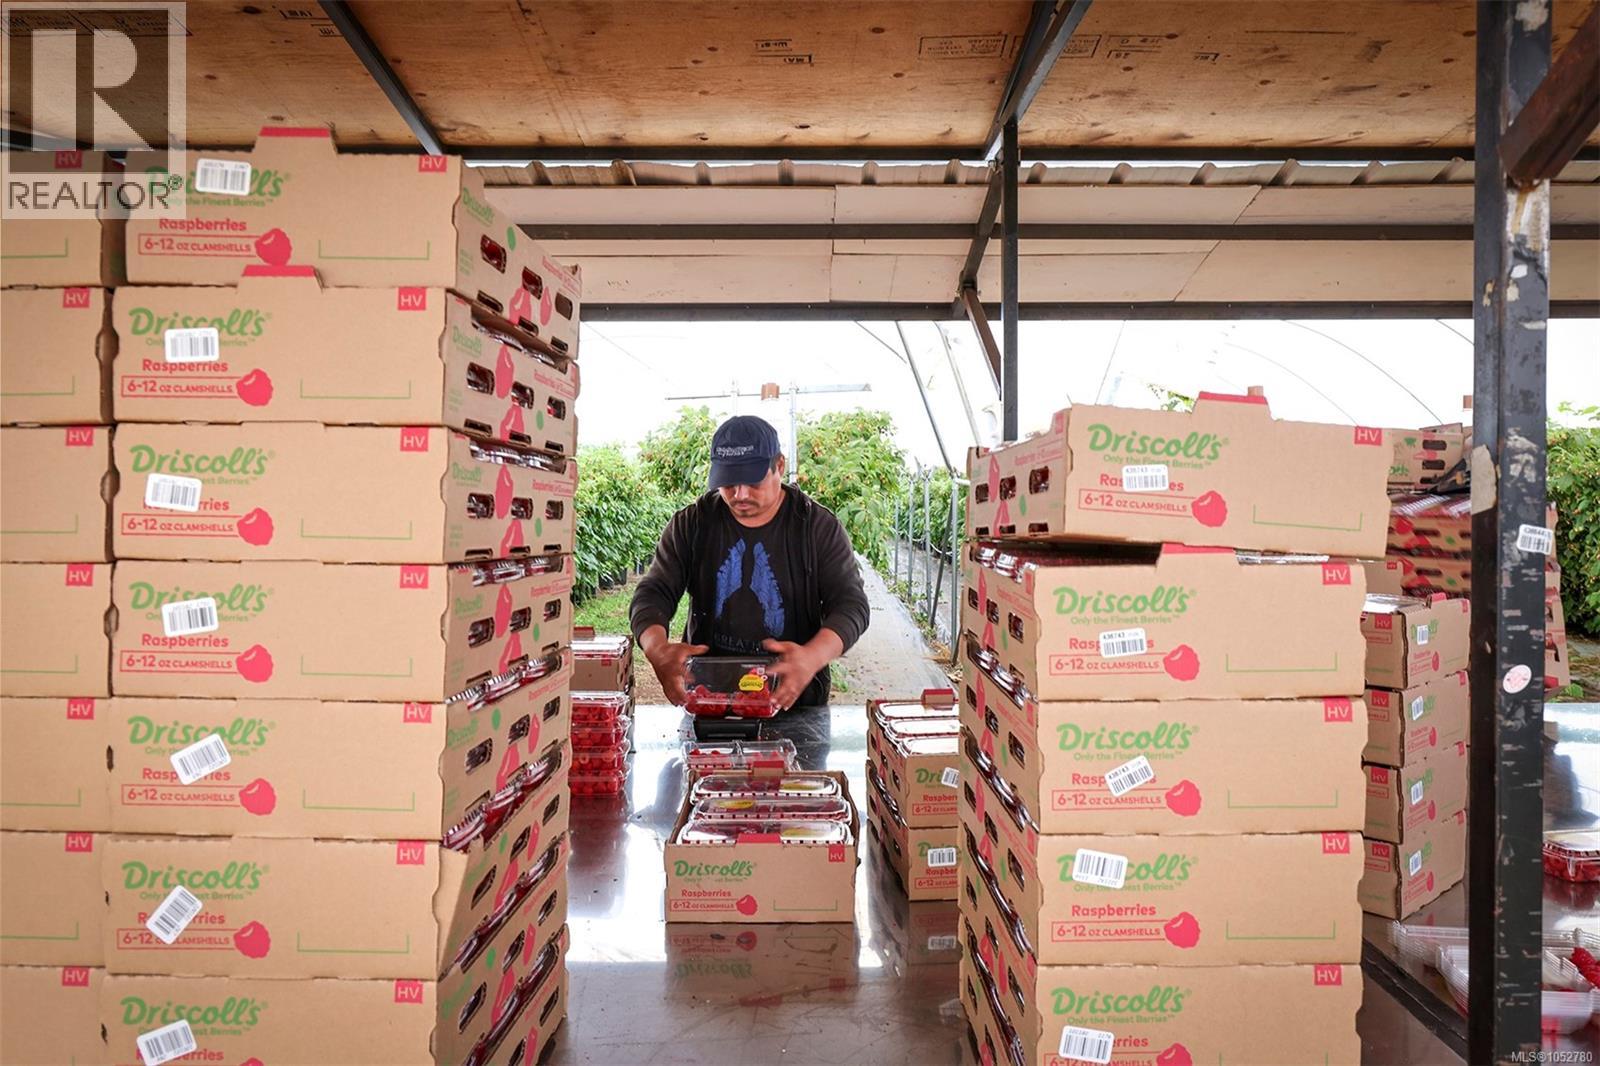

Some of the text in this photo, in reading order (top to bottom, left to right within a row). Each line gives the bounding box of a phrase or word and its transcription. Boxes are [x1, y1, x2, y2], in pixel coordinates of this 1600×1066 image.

[58, 153, 80, 164] HV
[422, 157, 443, 169] HV
[159, 217, 247, 232] Raspberries
[144, 238, 174, 250] 6-12
[191, 243, 251, 252] CLAMSHELLS
[66, 290, 88, 304] HV
[400, 295, 423, 306] HV
[142, 359, 229, 374] Raspberries
[127, 380, 233, 393] 6-12 OZ CLAMSHELLS
[68, 429, 91, 442] HV
[1357, 430, 1379, 442] HV
[403, 436, 425, 448] HV
[1087, 423, 1223, 461] Driscoll's
[130, 444, 268, 475] Driscoll's
[1103, 453, 1125, 465] Only
[1126, 455, 1141, 464] the
[1084, 493, 1113, 506] 6-12
[1129, 501, 1187, 512] CLAMSHELLS
[128, 518, 234, 532] 6-12 OZ CLAMSHELLS
[68, 571, 90, 583] HV
[403, 572, 425, 584] HV
[1325, 568, 1348, 581] HV
[1052, 585, 1189, 614] Driscoll's
[1070, 616, 1090, 625] Only
[1093, 616, 1109, 624] the
[142, 634, 229, 649] Raspberries
[126, 655, 232, 669] 6-12 OZ CLAMSHELLS
[1055, 659, 1084, 670] 6-12
[1100, 661, 1160, 670] CLAMSHELLS
[70, 704, 91, 716] HV
[407, 707, 429, 719] HV
[1327, 707, 1349, 718] HV
[1056, 721, 1193, 751] Driscoll's
[1073, 752, 1094, 761] Only
[1096, 752, 1111, 760] the
[127, 788, 235, 802] 6-12 OZ CLAMSHELLS
[923, 794, 958, 802] Raspber
[1057, 793, 1161, 805] 6-12 OZ CLAMSHELLS
[68, 837, 90, 848] HV
[1325, 838, 1347, 850] HV
[399, 849, 422, 862] HV
[830, 852, 844, 861] HV
[674, 860, 753, 876] Driscoll's
[121, 861, 263, 889] Driscoll's
[681, 889, 731, 898] Raspberries
[673, 901, 691, 909] 6-12
[1071, 904, 1156, 918] Raspberries
[1057, 925, 1160, 937] 6-12 OZ CLAMSHELLS
[123, 933, 152, 944] 6-12
[173, 937, 230, 945] LAMSHELLS
[65, 971, 87, 982] HV
[1317, 969, 1338, 981] HV
[398, 987, 420, 999] HV
[1051, 985, 1184, 1014] Driscoll's
[120, 996, 261, 1025] Driscoll's
[1067, 1016, 1088, 1026] Only
[1089, 1016, 1105, 1024] the
